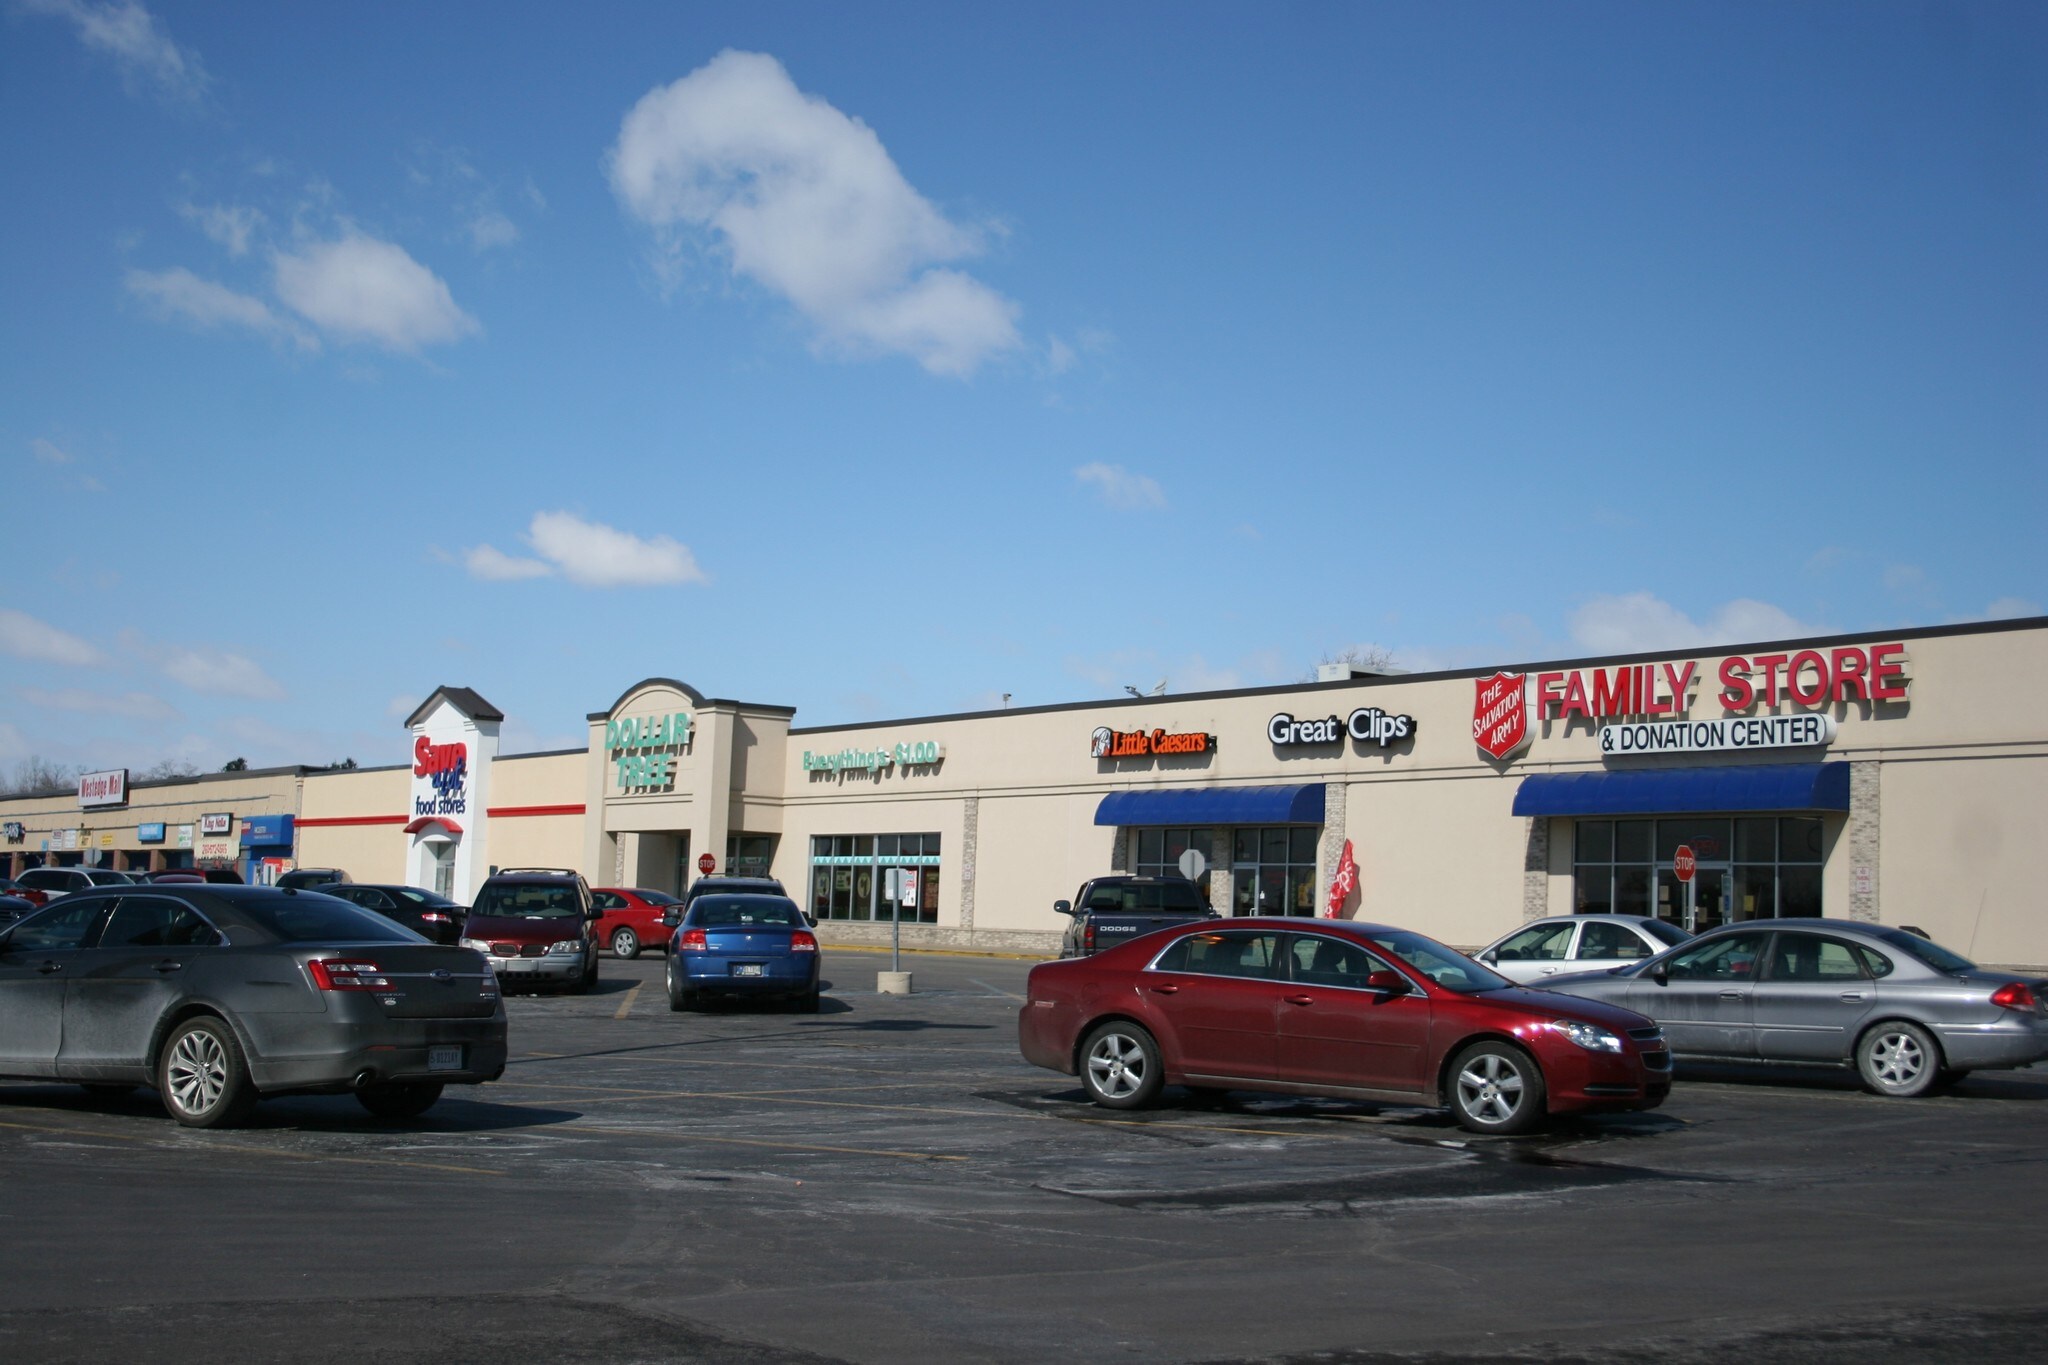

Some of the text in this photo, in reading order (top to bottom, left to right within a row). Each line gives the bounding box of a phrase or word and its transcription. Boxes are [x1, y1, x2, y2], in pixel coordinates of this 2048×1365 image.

[1481, 681, 1502, 708] THE
[1538, 643, 1905, 720] FAMILY STORE
[1268, 709, 1408, 746] Great Clips
[1474, 685, 1520, 738] SALVATION
[605, 713, 689, 750] DOLLAR
[1112, 728, 1206, 756] Little Caesars
[1491, 710, 1519, 749] ARMY
[1602, 716, 1819, 751] & DONATION CENTER
[414, 736, 467, 777] Save
[617, 753, 671, 787] TREE
[803, 741, 938, 773] Everything's $1.00
[109, 774, 122, 795] Mall
[416, 795, 466, 815] food stores
[699, 859, 715, 868] STOP
[1676, 857, 1693, 870] STOP
